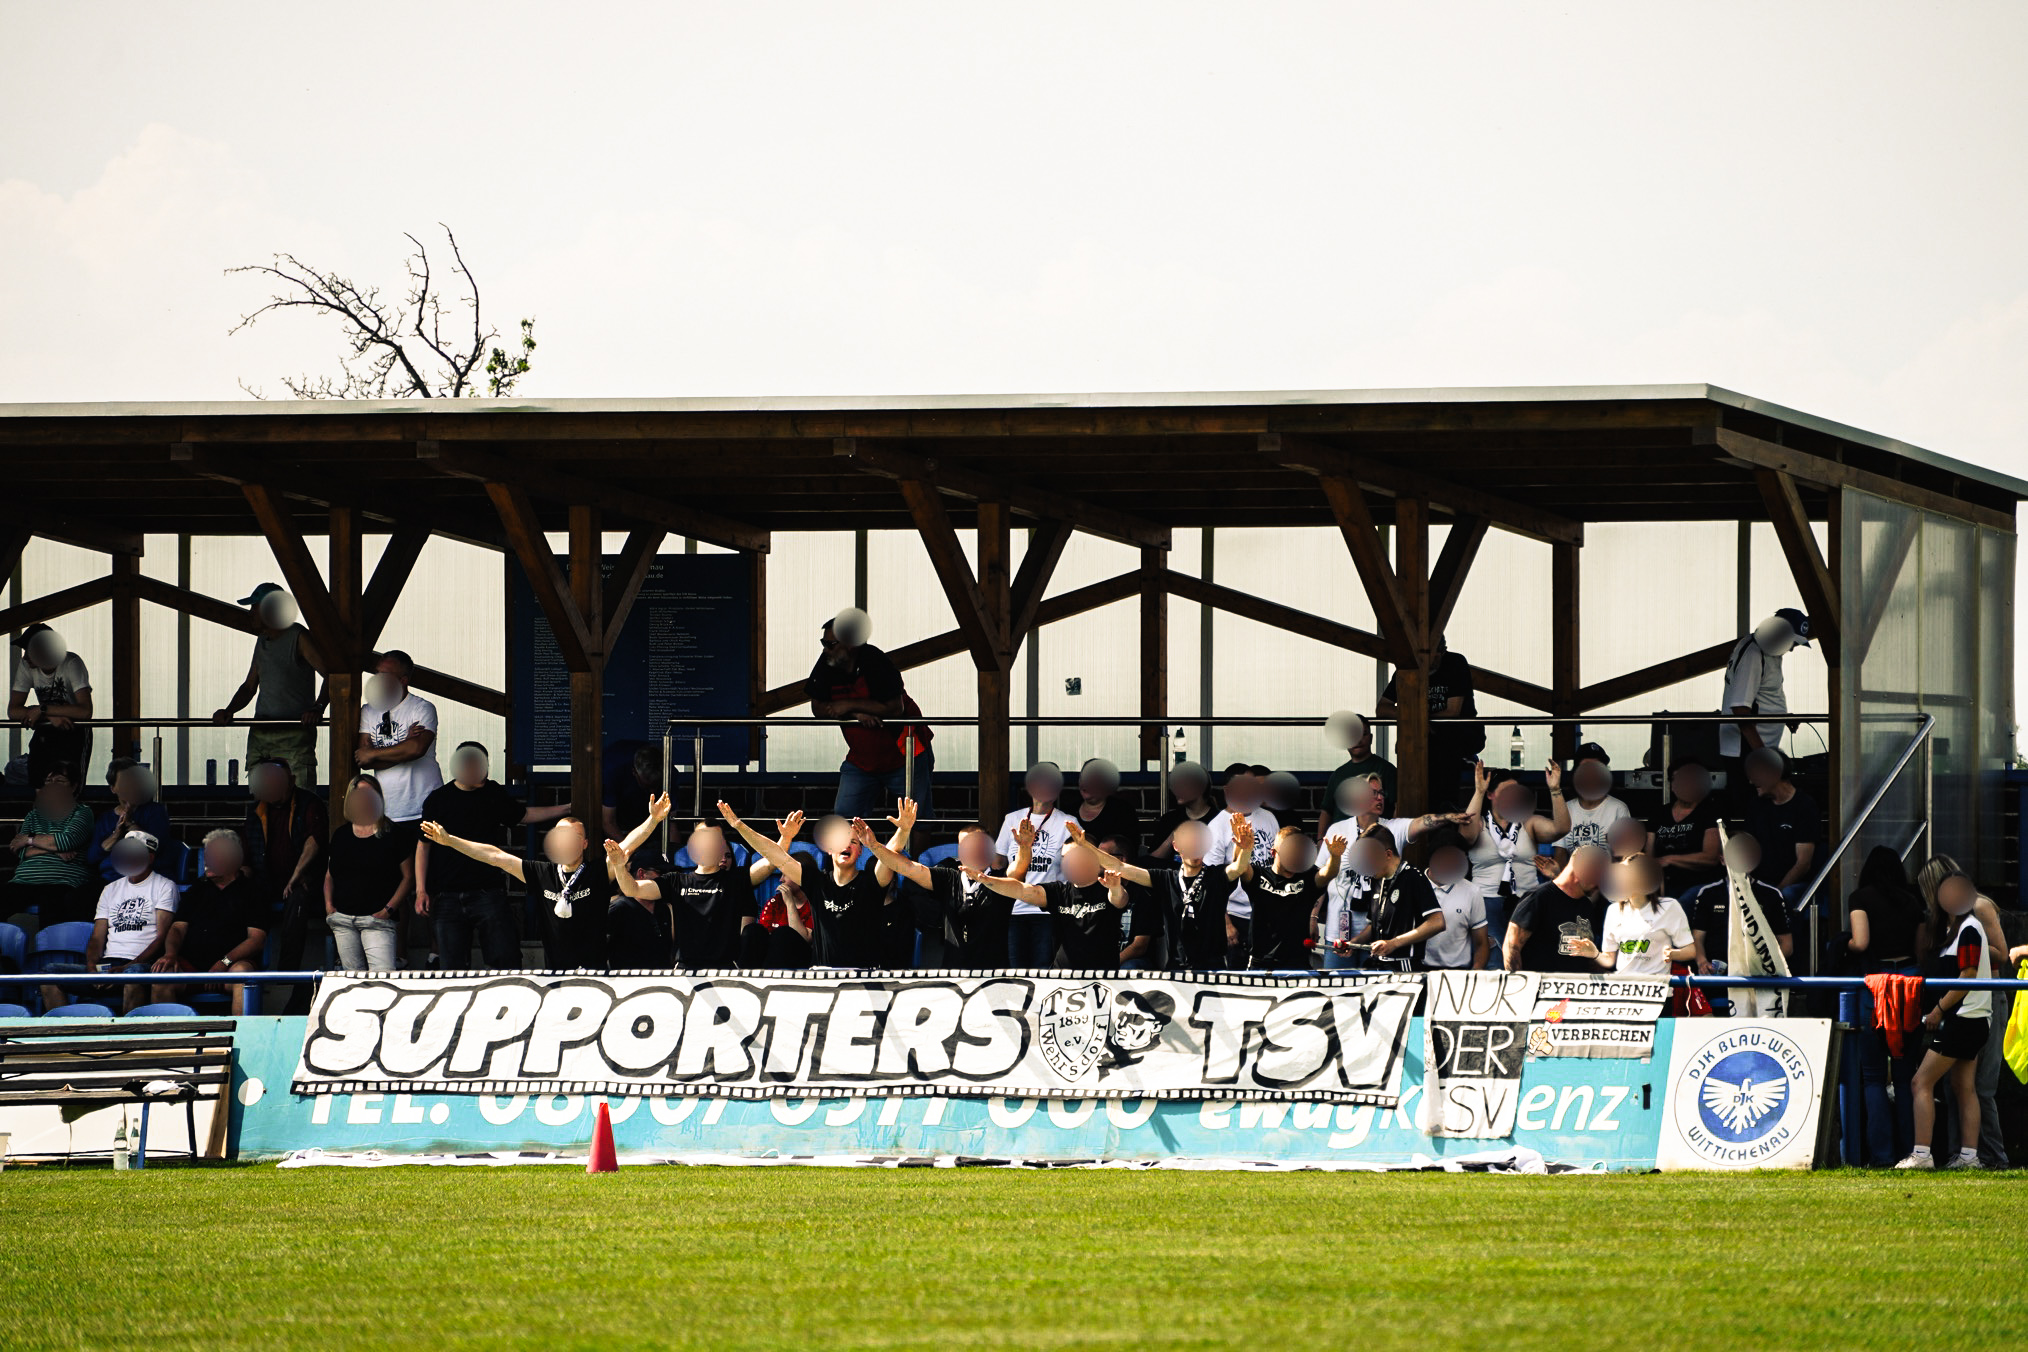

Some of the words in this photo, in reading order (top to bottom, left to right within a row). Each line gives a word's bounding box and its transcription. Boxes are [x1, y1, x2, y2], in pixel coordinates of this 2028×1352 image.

[1574, 823, 1600, 836] TSV
[1031, 856, 1052, 865] ahre
[121, 898, 146, 910] TSV
[1433, 972, 1529, 1017] NUR
[1541, 981, 1666, 998] PYROTECHNIK
[1043, 983, 1110, 1018] TSV
[1576, 1006, 1602, 1016] IST
[1605, 1007, 1644, 1016] KEIN
[303, 977, 1035, 1082] SUPPORTERS
[1059, 1014, 1089, 1029] 1859
[1064, 1036, 1085, 1048] e.V.
[1189, 990, 1416, 1091] TSV
[1551, 1028, 1652, 1043] VERBRECHEN
[1041, 1022, 1108, 1076] Wehrsdorf
[1688, 1050, 1715, 1080] DJK
[1718, 1033, 1806, 1081] BLAU-WEISS
[1733, 1092, 1755, 1107] DJK
[1688, 1126, 1790, 1161] WITTICHENAU
